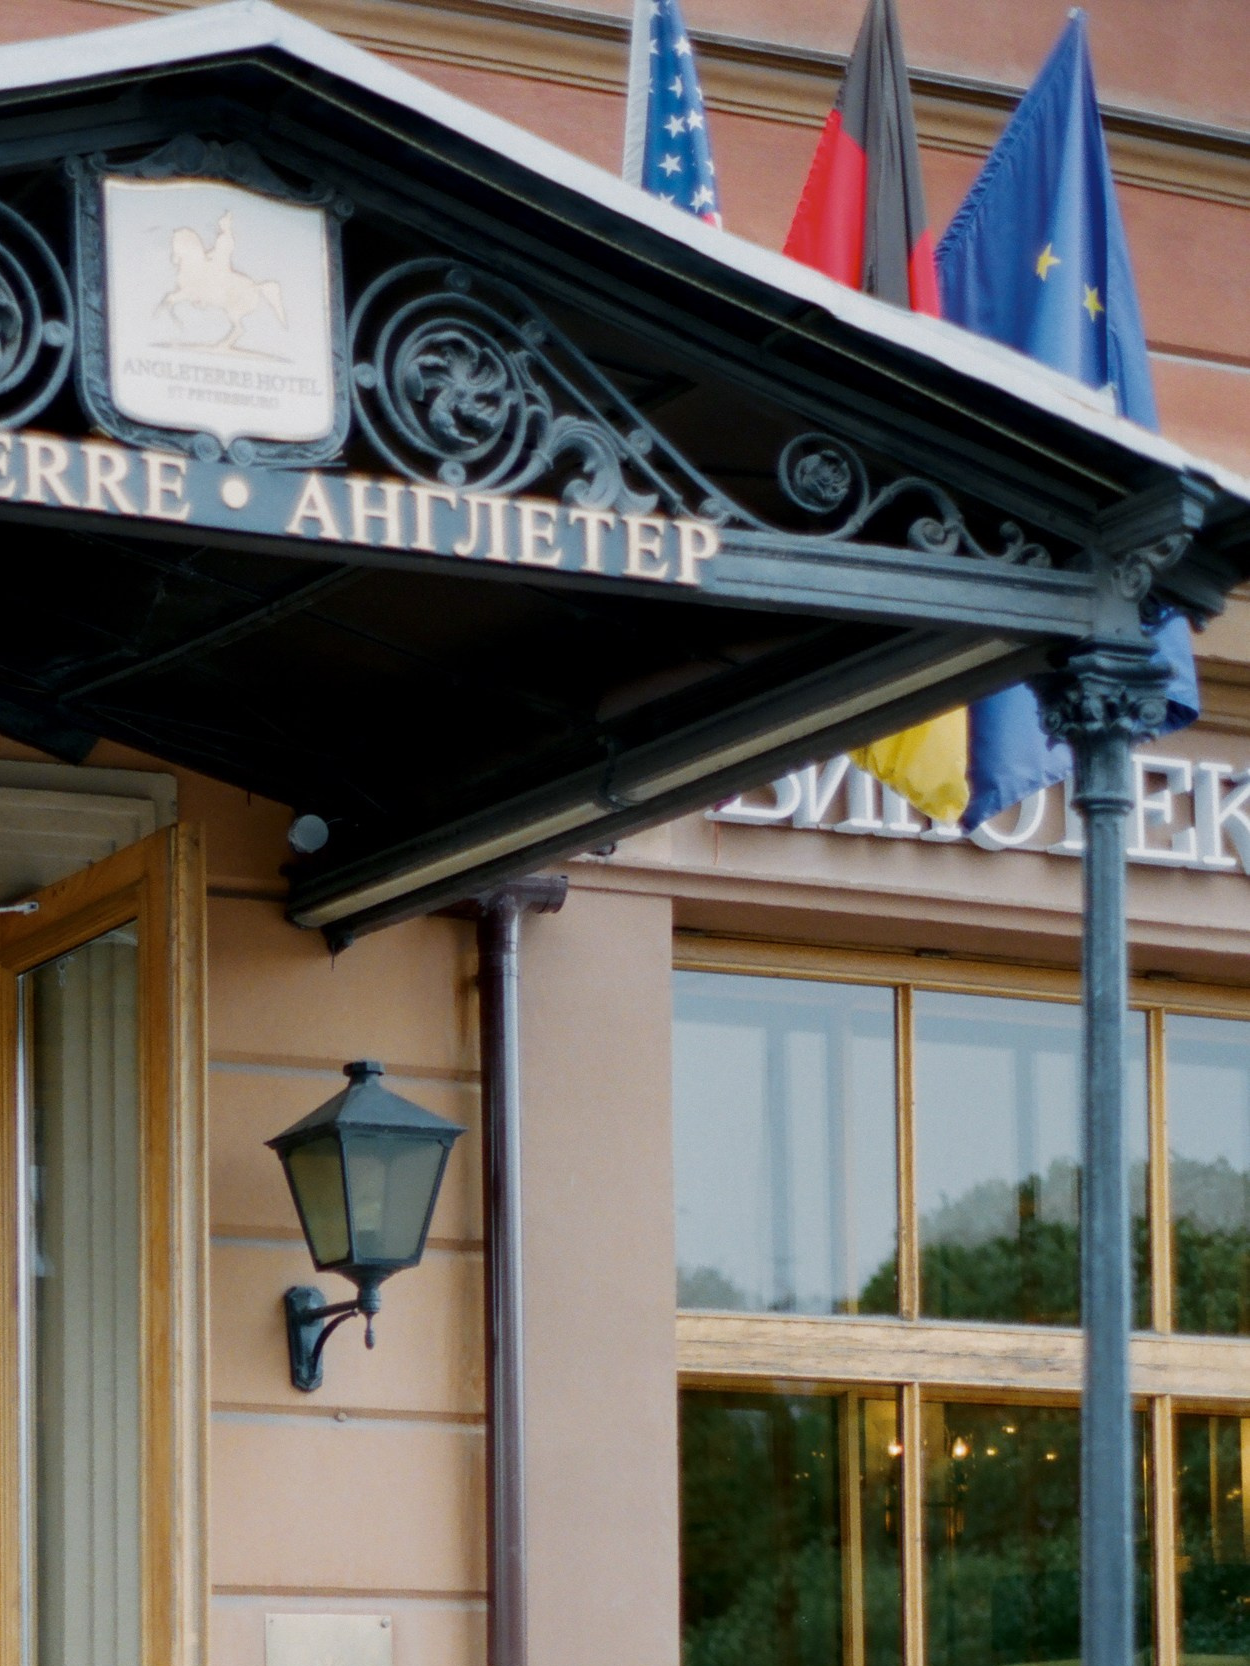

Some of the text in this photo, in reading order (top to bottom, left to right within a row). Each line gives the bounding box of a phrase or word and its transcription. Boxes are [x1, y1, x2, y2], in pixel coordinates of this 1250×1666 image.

[123, 357, 323, 397] ANGLETERRE HOTEL
[285, 470, 720, 586] АНГЛЕТЕР
[706, 753, 1250, 874] ИОЕК
